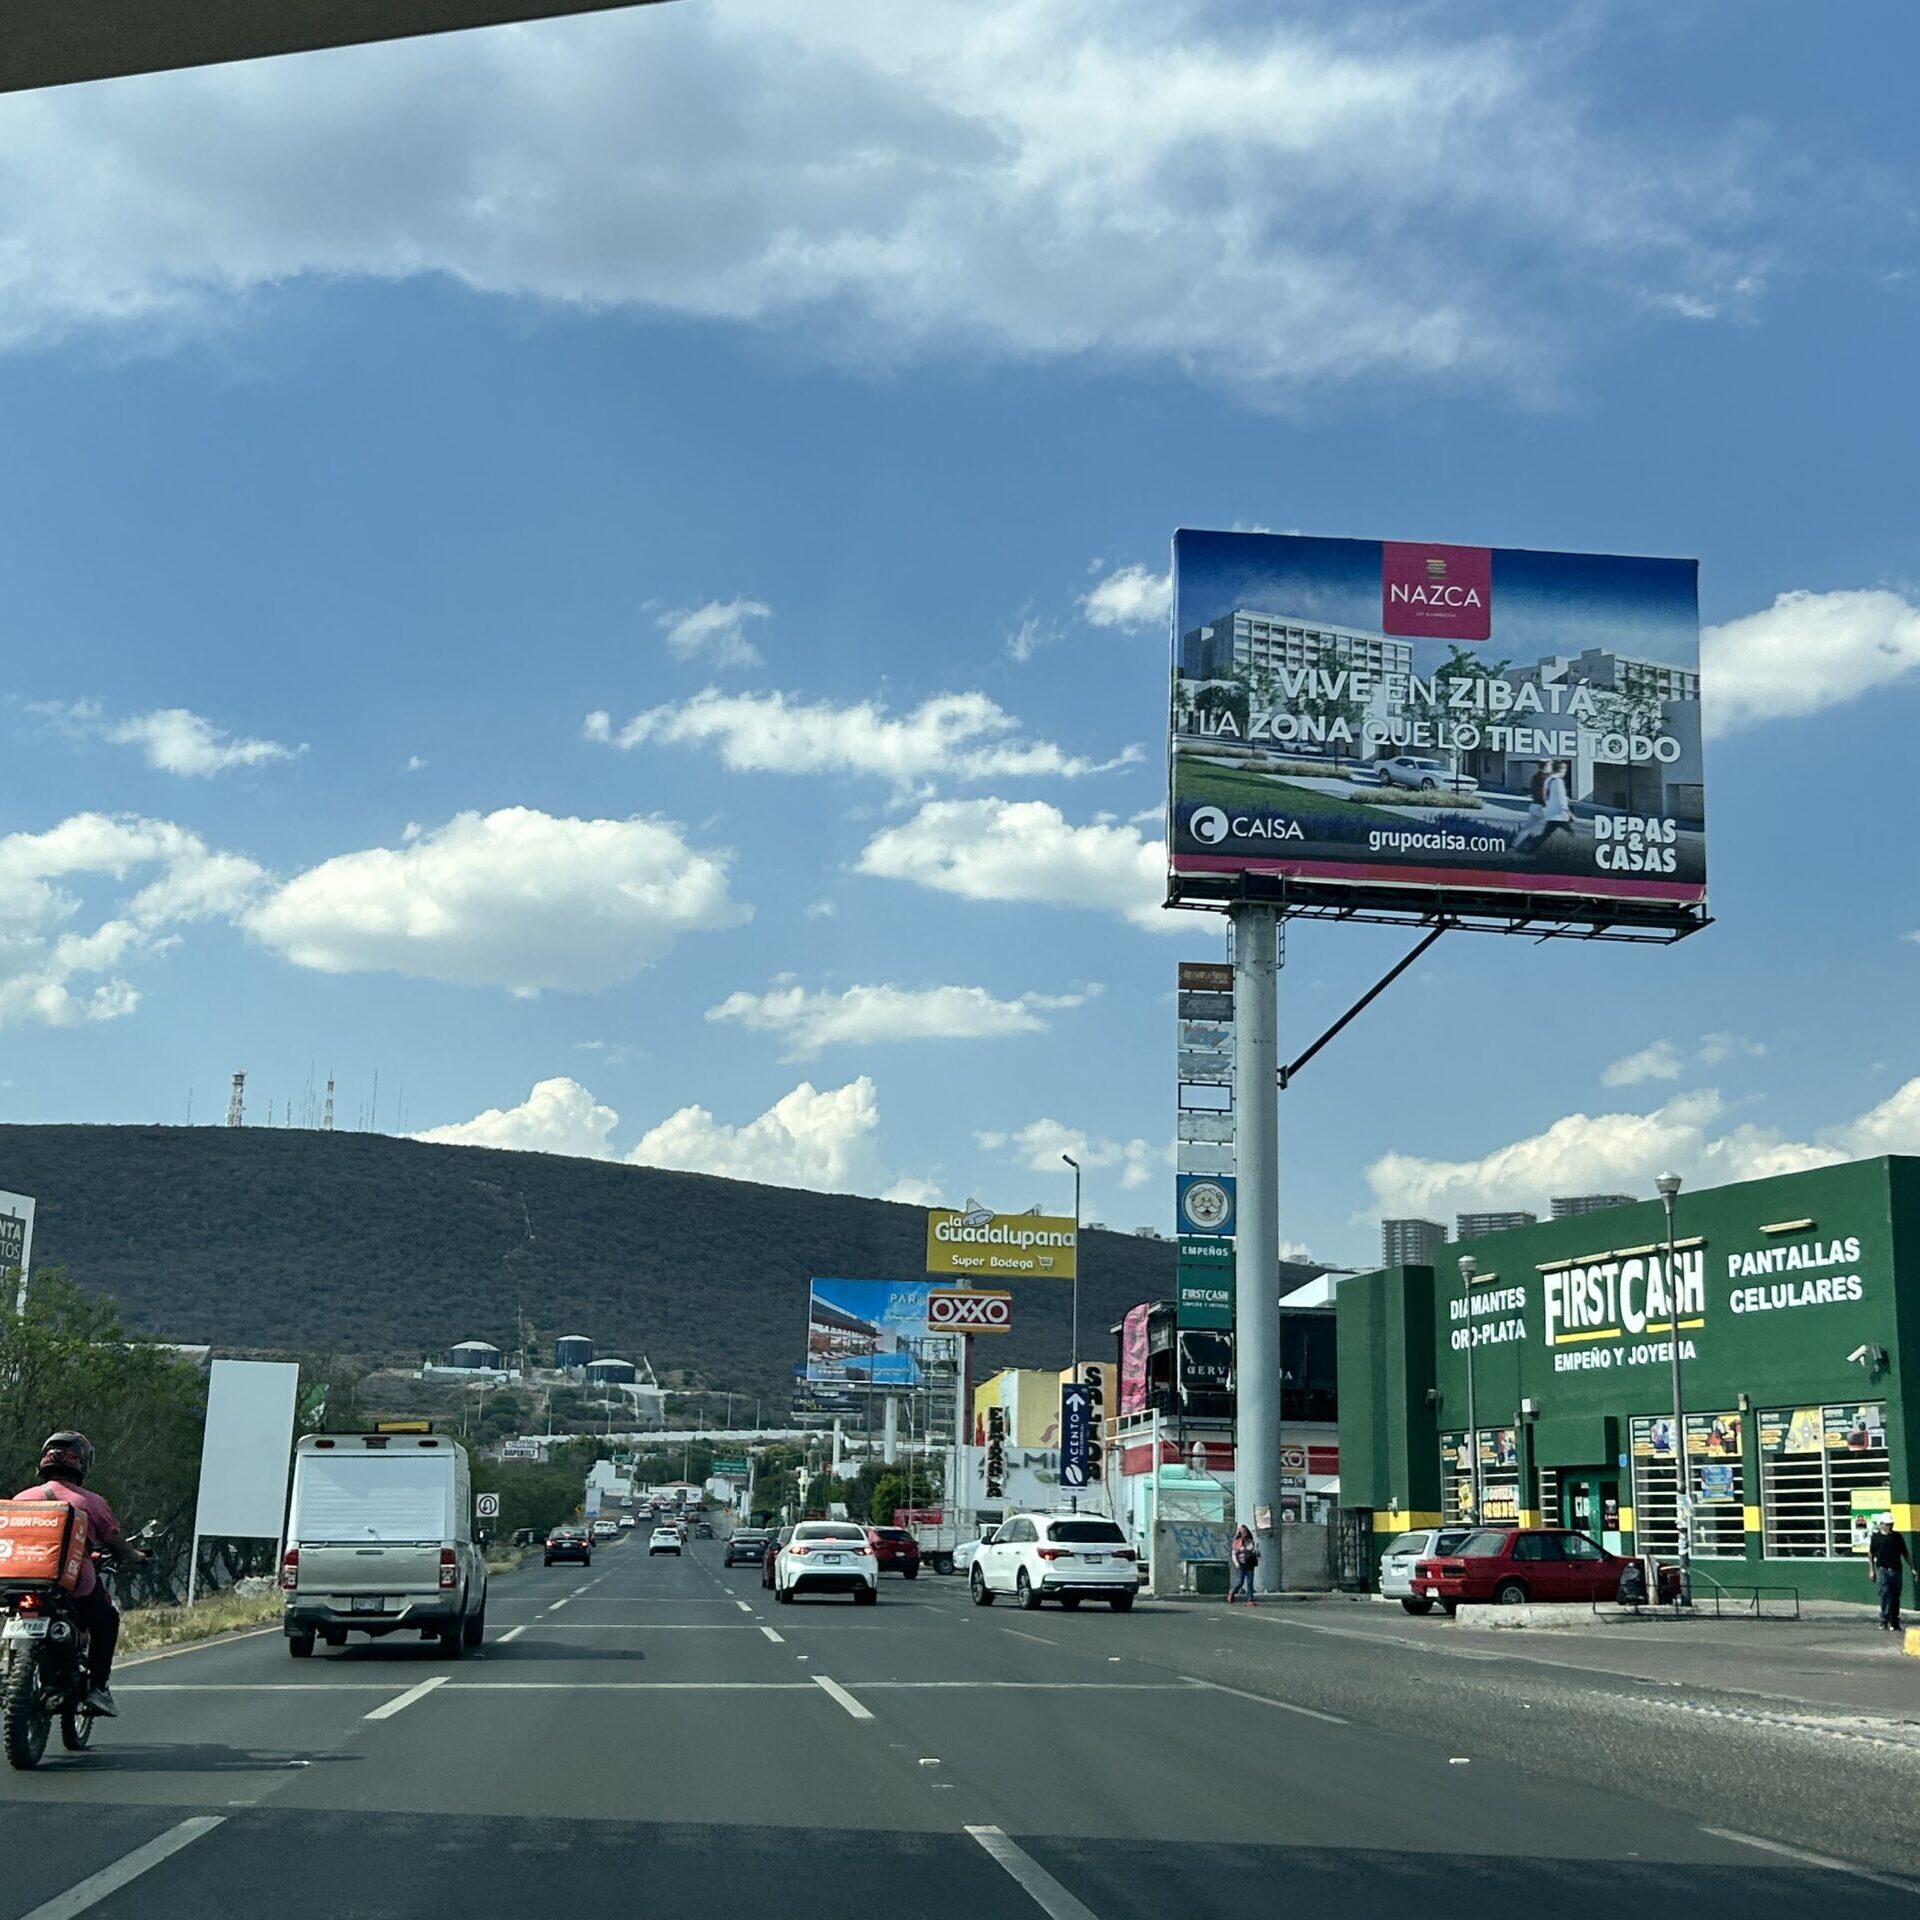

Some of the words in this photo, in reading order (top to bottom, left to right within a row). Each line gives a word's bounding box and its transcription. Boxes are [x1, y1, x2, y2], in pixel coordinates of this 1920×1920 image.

[1391, 584, 1481, 608] NAZCA
[1278, 668, 1372, 702] VIVE
[1385, 674, 1437, 706] EN
[1449, 677, 1598, 716] ZIBATÁ
[1200, 709, 1241, 737] LA
[1249, 712, 1354, 744] ZONA
[1361, 718, 1432, 748] QUE
[1437, 722, 1481, 751] LO
[1485, 725, 1578, 757] TIENE
[1583, 731, 1681, 763] TODO
[1232, 816, 1305, 840] CAISA
[1369, 830, 1506, 853] grupocaisa.com
[1594, 814, 1677, 844] DEPAS
[1628, 832, 1645, 852] &
[1595, 844, 1677, 873] CASAS
[935, 1221, 1076, 1250] Guadalupana
[950, 1215, 963, 1227] la
[952, 1254, 985, 1268] Super
[990, 1256, 1034, 1270] Bodega
[1181, 1246, 1229, 1257] EMPEÑOS
[1728, 1237, 1861, 1278] PANTALLAS
[1450, 1286, 1526, 1320] DIAMANTES
[1543, 1250, 1705, 1347] FIRSTCASH
[1729, 1274, 1863, 1314] CELULARES
[931, 1298, 1009, 1323] OXXO
[1451, 1318, 1527, 1351] ORO-PLATA
[1554, 1346, 1611, 1372] EMPEÑO
[1613, 1347, 1625, 1366] Y
[1069, 1414, 1080, 1464] ACENTO
[32, 1517, 59, 1527] Food
